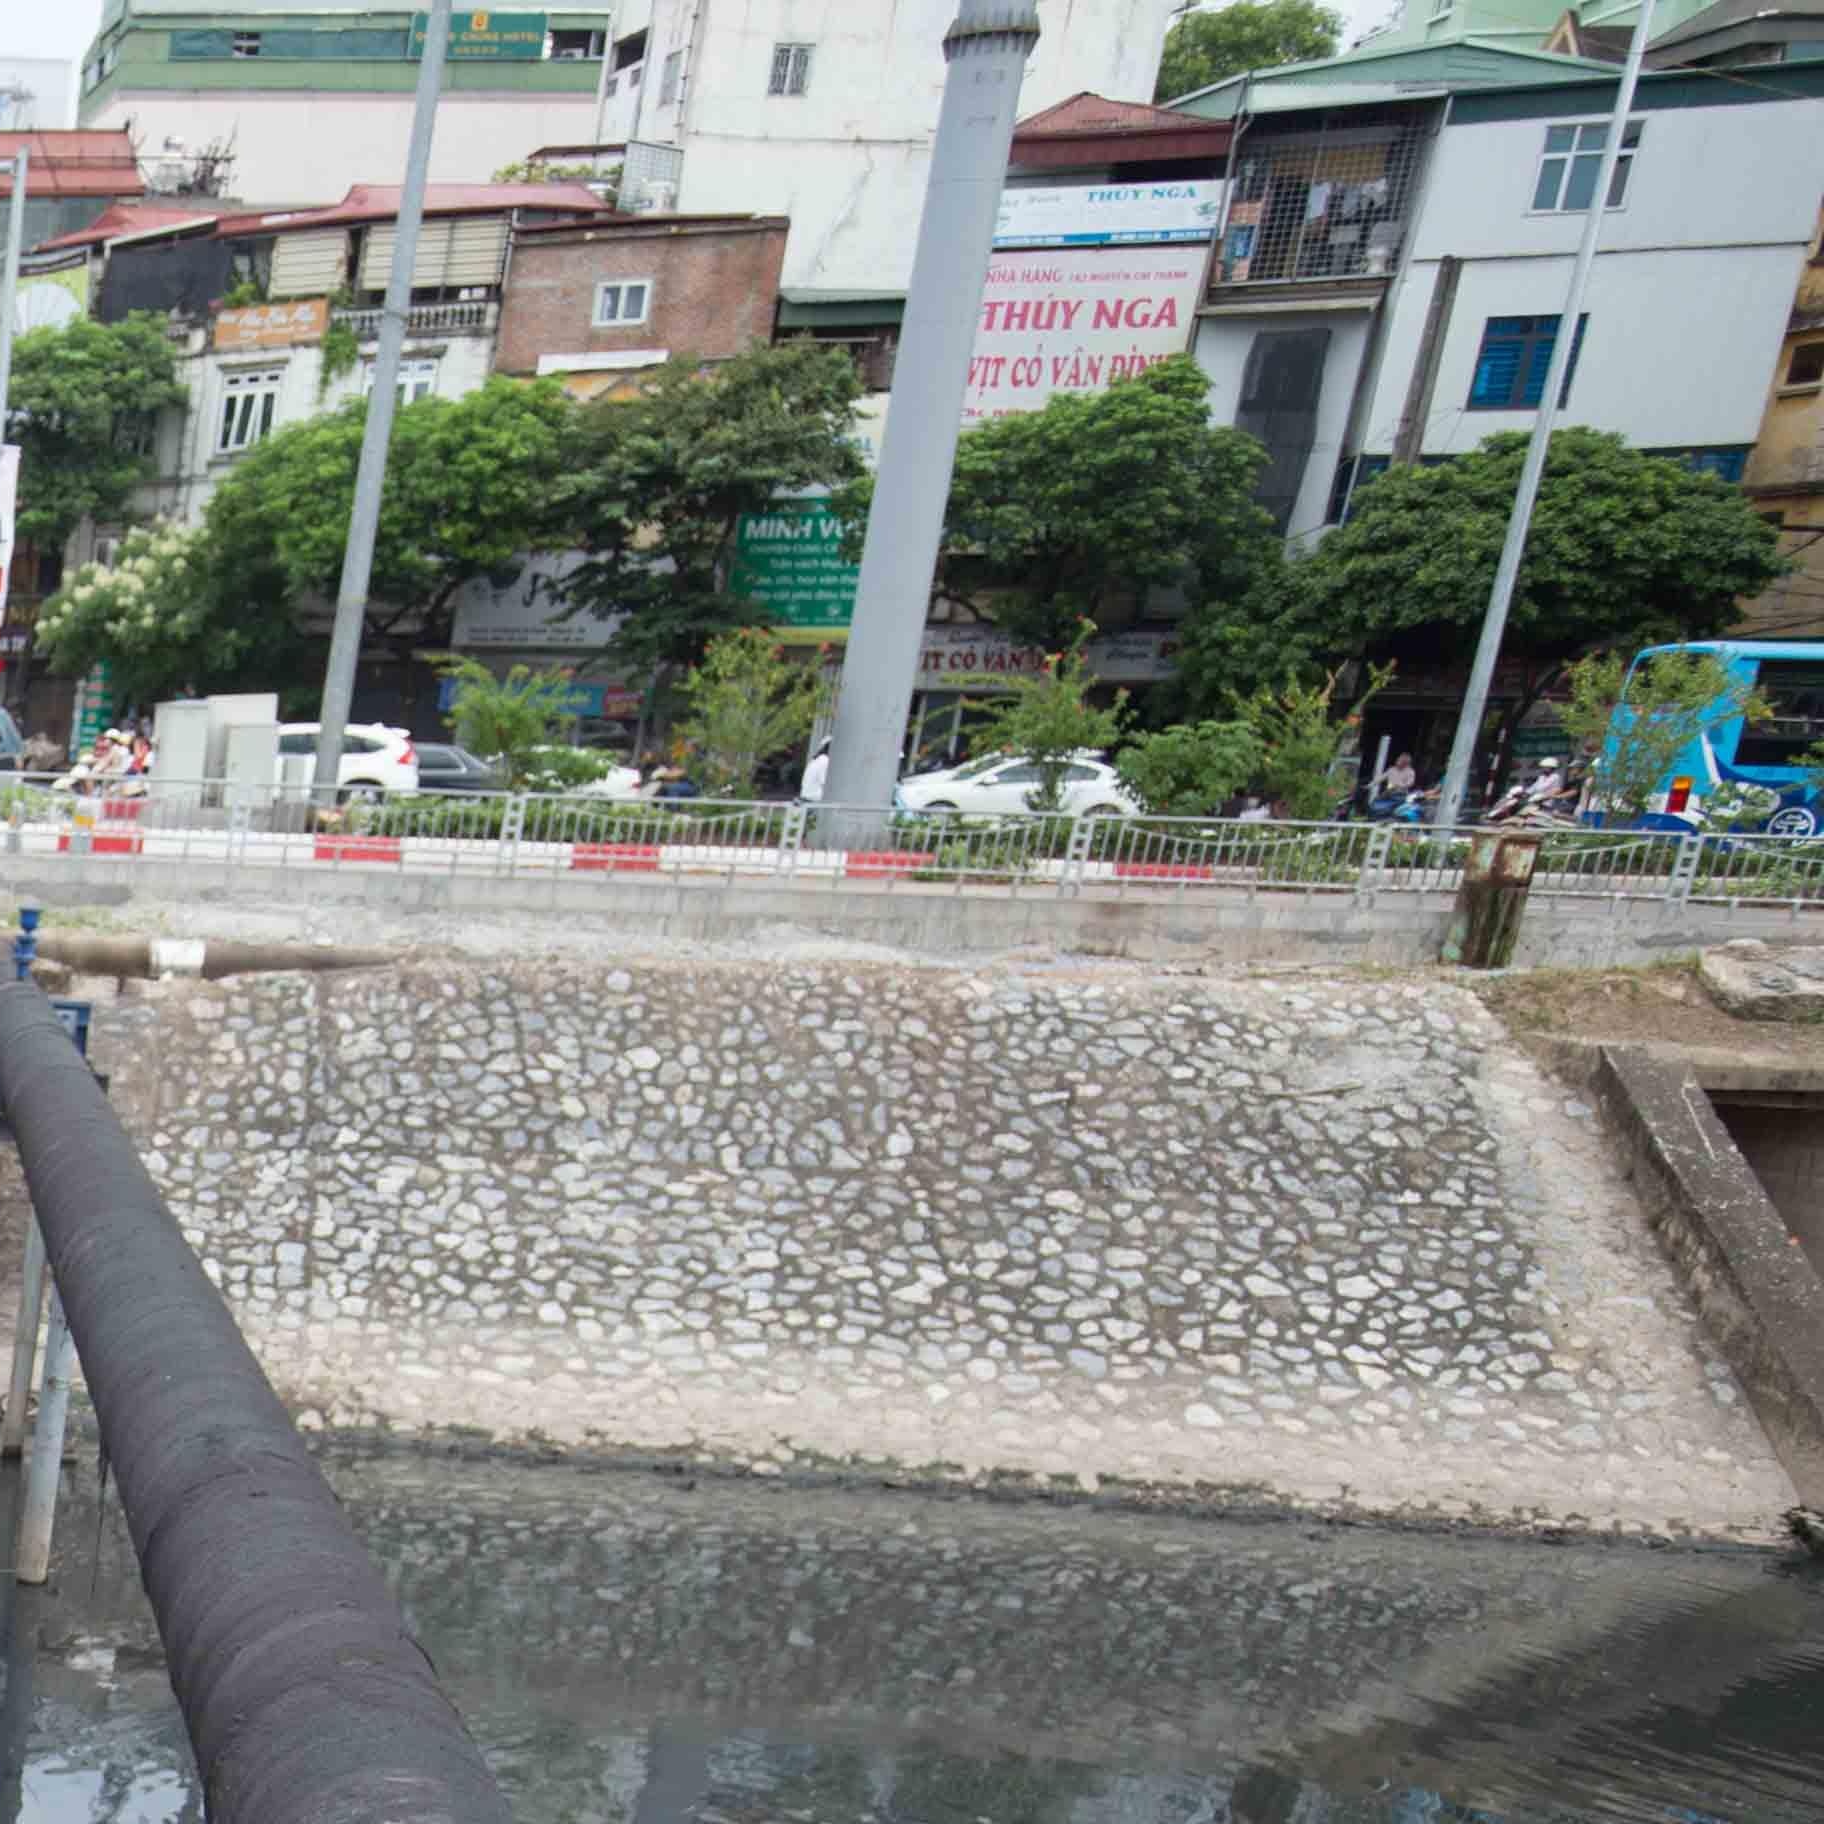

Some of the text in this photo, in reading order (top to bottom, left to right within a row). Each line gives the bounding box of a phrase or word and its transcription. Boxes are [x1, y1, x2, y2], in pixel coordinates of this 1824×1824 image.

[1151, 184, 1197, 199] NGA
[1092, 296, 1178, 329] NGA
[745, 517, 814, 540] MINH
